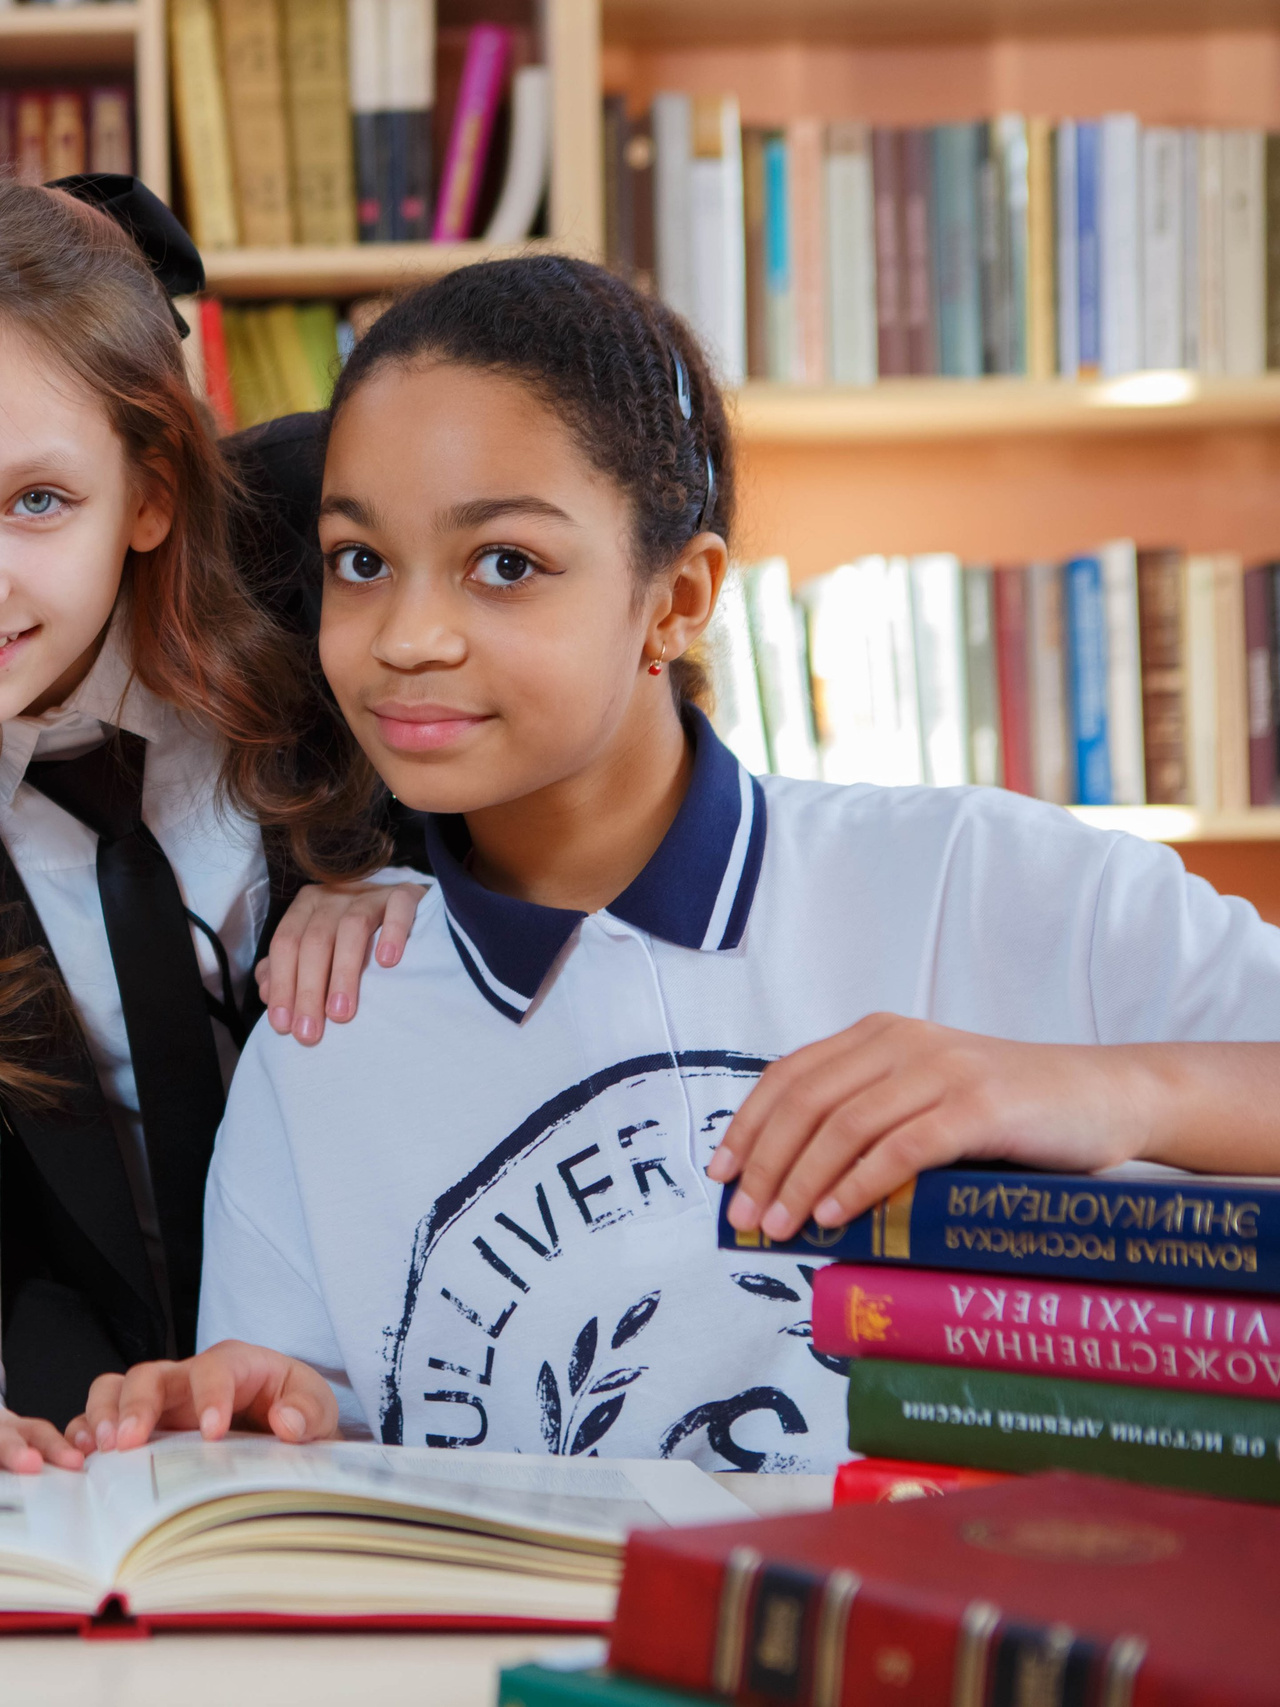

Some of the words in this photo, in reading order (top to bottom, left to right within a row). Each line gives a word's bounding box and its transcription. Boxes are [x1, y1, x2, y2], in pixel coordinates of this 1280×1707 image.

[947, 1182, 1260, 1238] ЭНЦИКЛОПЕДИЯ
[944, 1226, 1116, 1261] РОССИЙСКАЯ
[1125, 1237, 1258, 1273] БОЛЬШАЯ
[949, 1285, 1061, 1327] ВЕКА
[902, 1400, 992, 1428] РОССИИ
[997, 1409, 1104, 1439] ДРЕВНЕЙ
[1109, 1420, 1223, 1453] ИСТОРИИ
[1232, 1433, 1266, 1458] ОБ
